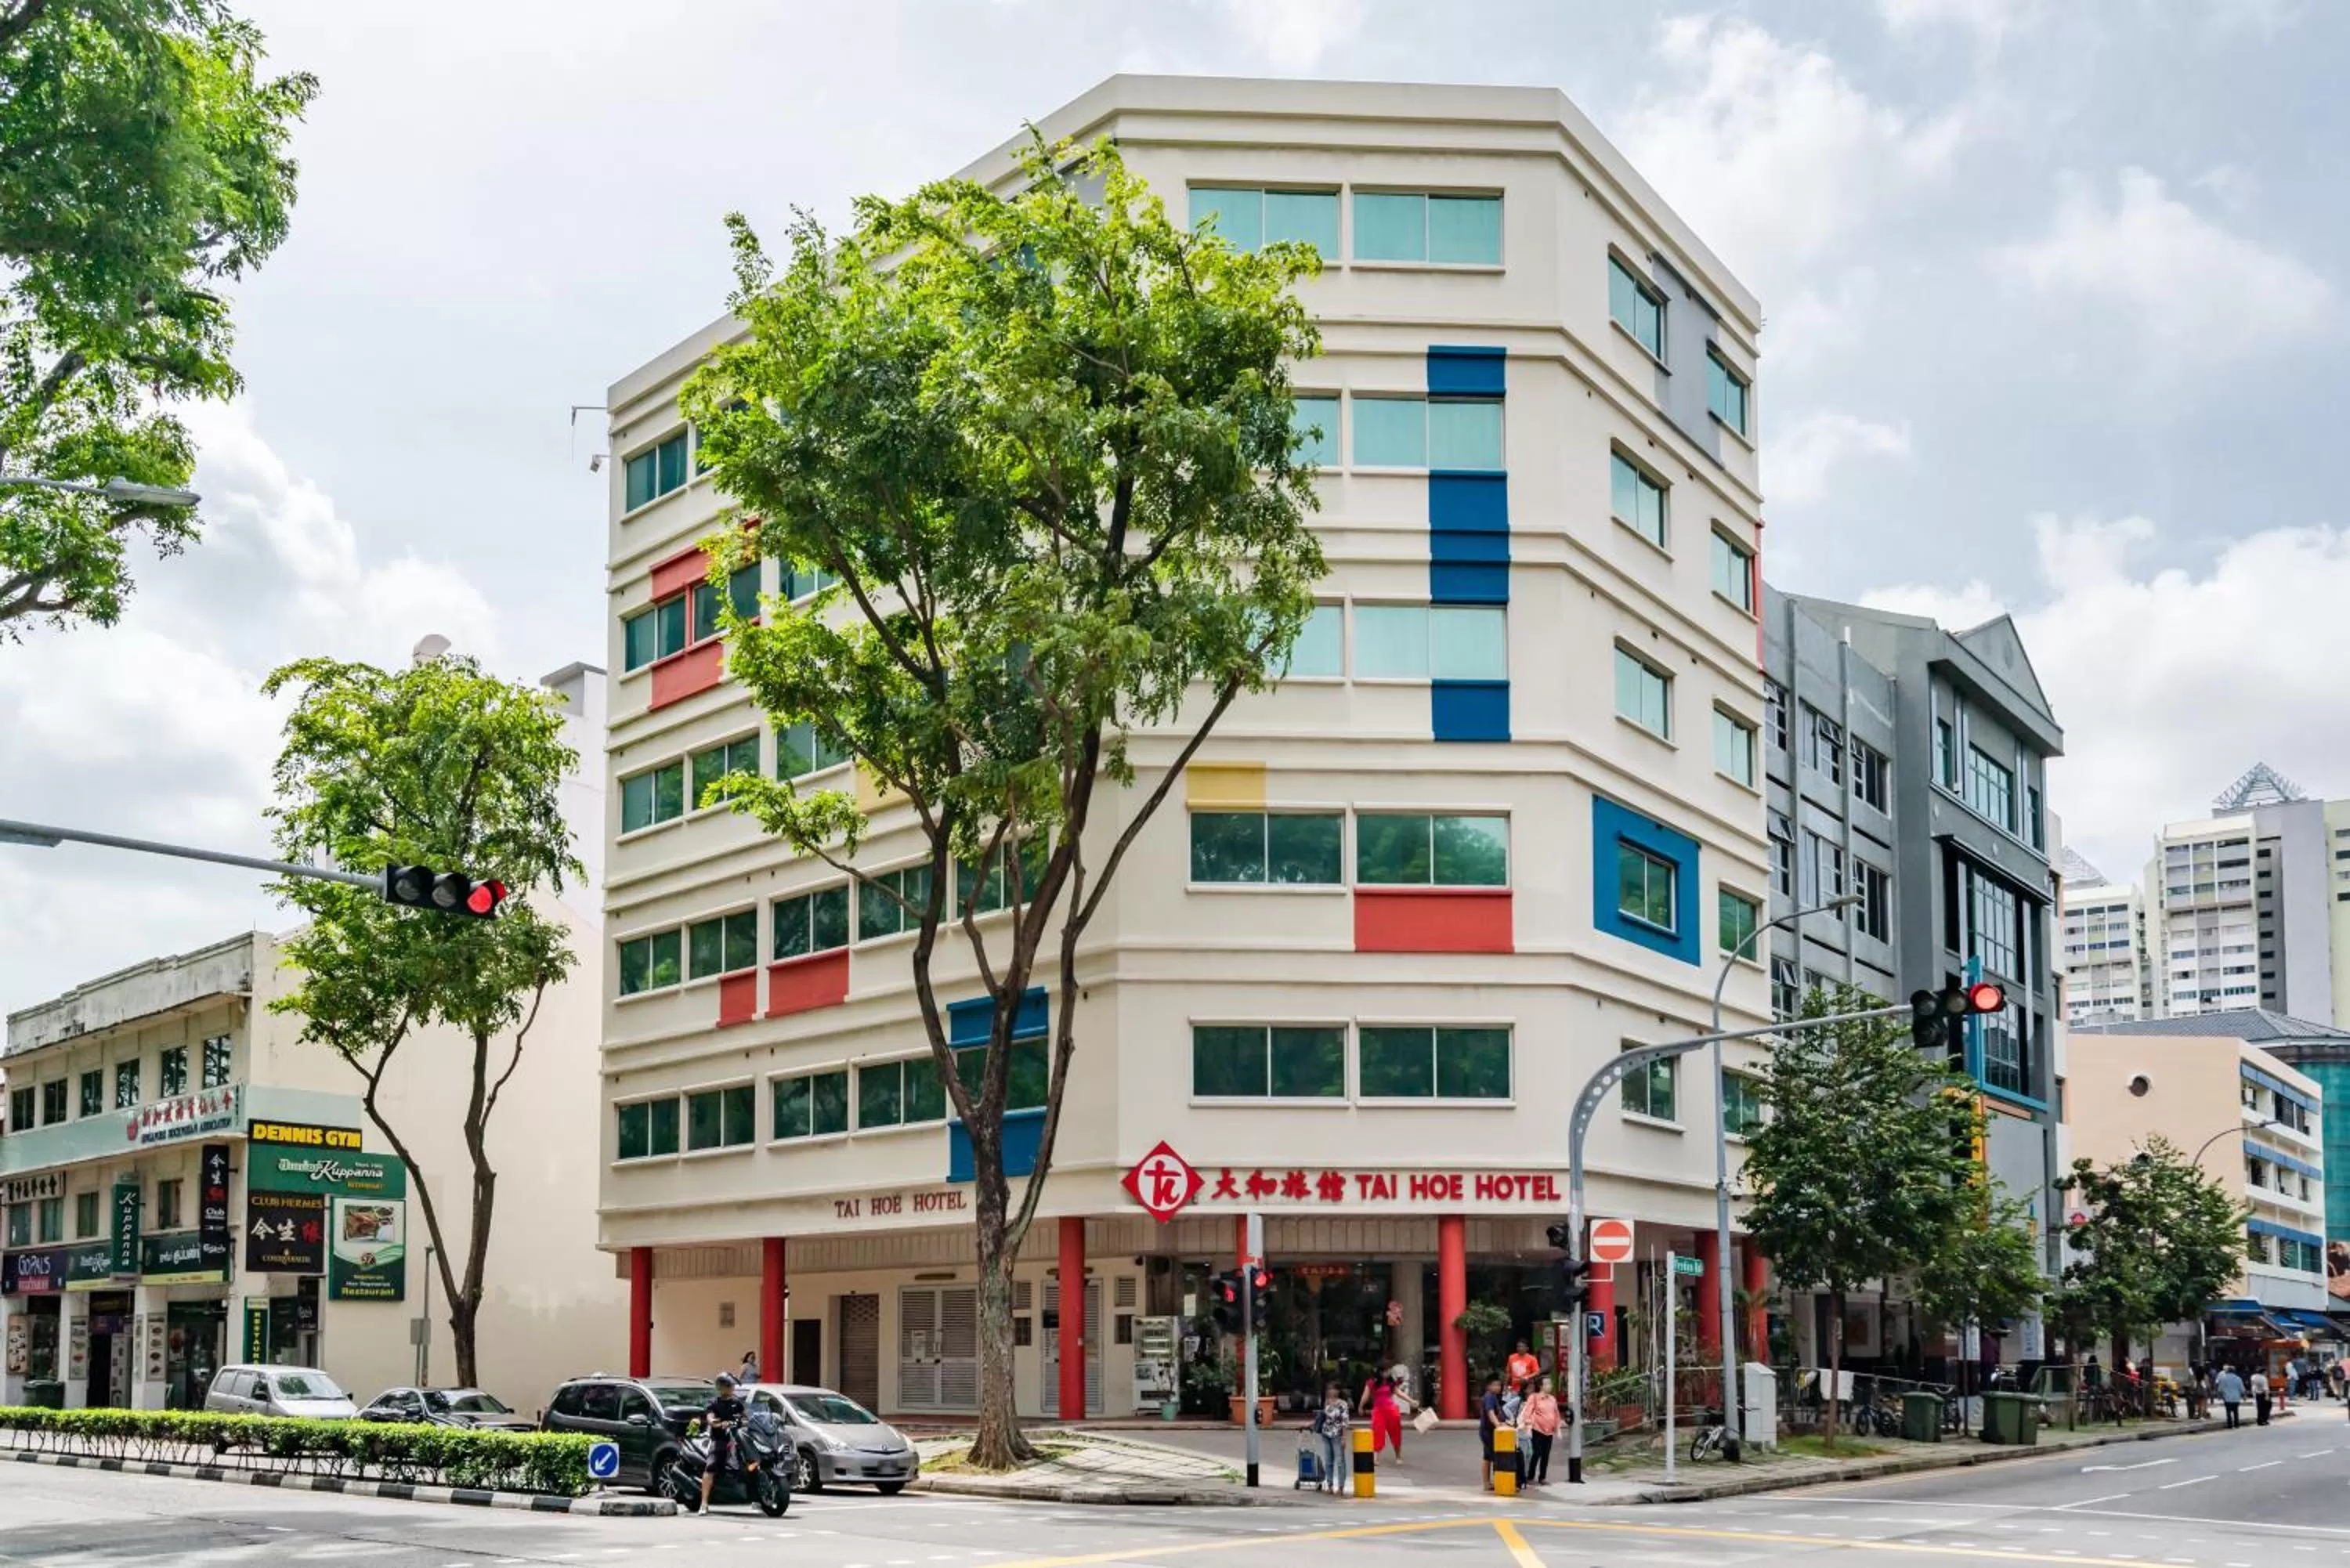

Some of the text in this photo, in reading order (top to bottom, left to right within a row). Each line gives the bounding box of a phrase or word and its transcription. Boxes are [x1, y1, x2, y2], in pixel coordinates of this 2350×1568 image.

[252, 1123, 362, 1148] DENNIS GYM
[309, 1160, 384, 1182] Kuppanna
[1354, 1174, 1397, 1201] TAI
[1410, 1174, 1463, 1201] HOE
[1474, 1175, 1561, 1201] HOTEL
[251, 1196, 324, 1209] CLUB HERMES
[834, 1190, 967, 1219] TAI HOE HOTEL
[118, 1191, 138, 1266] Kuppanna
[342, 1287, 395, 1296] Restaurant
